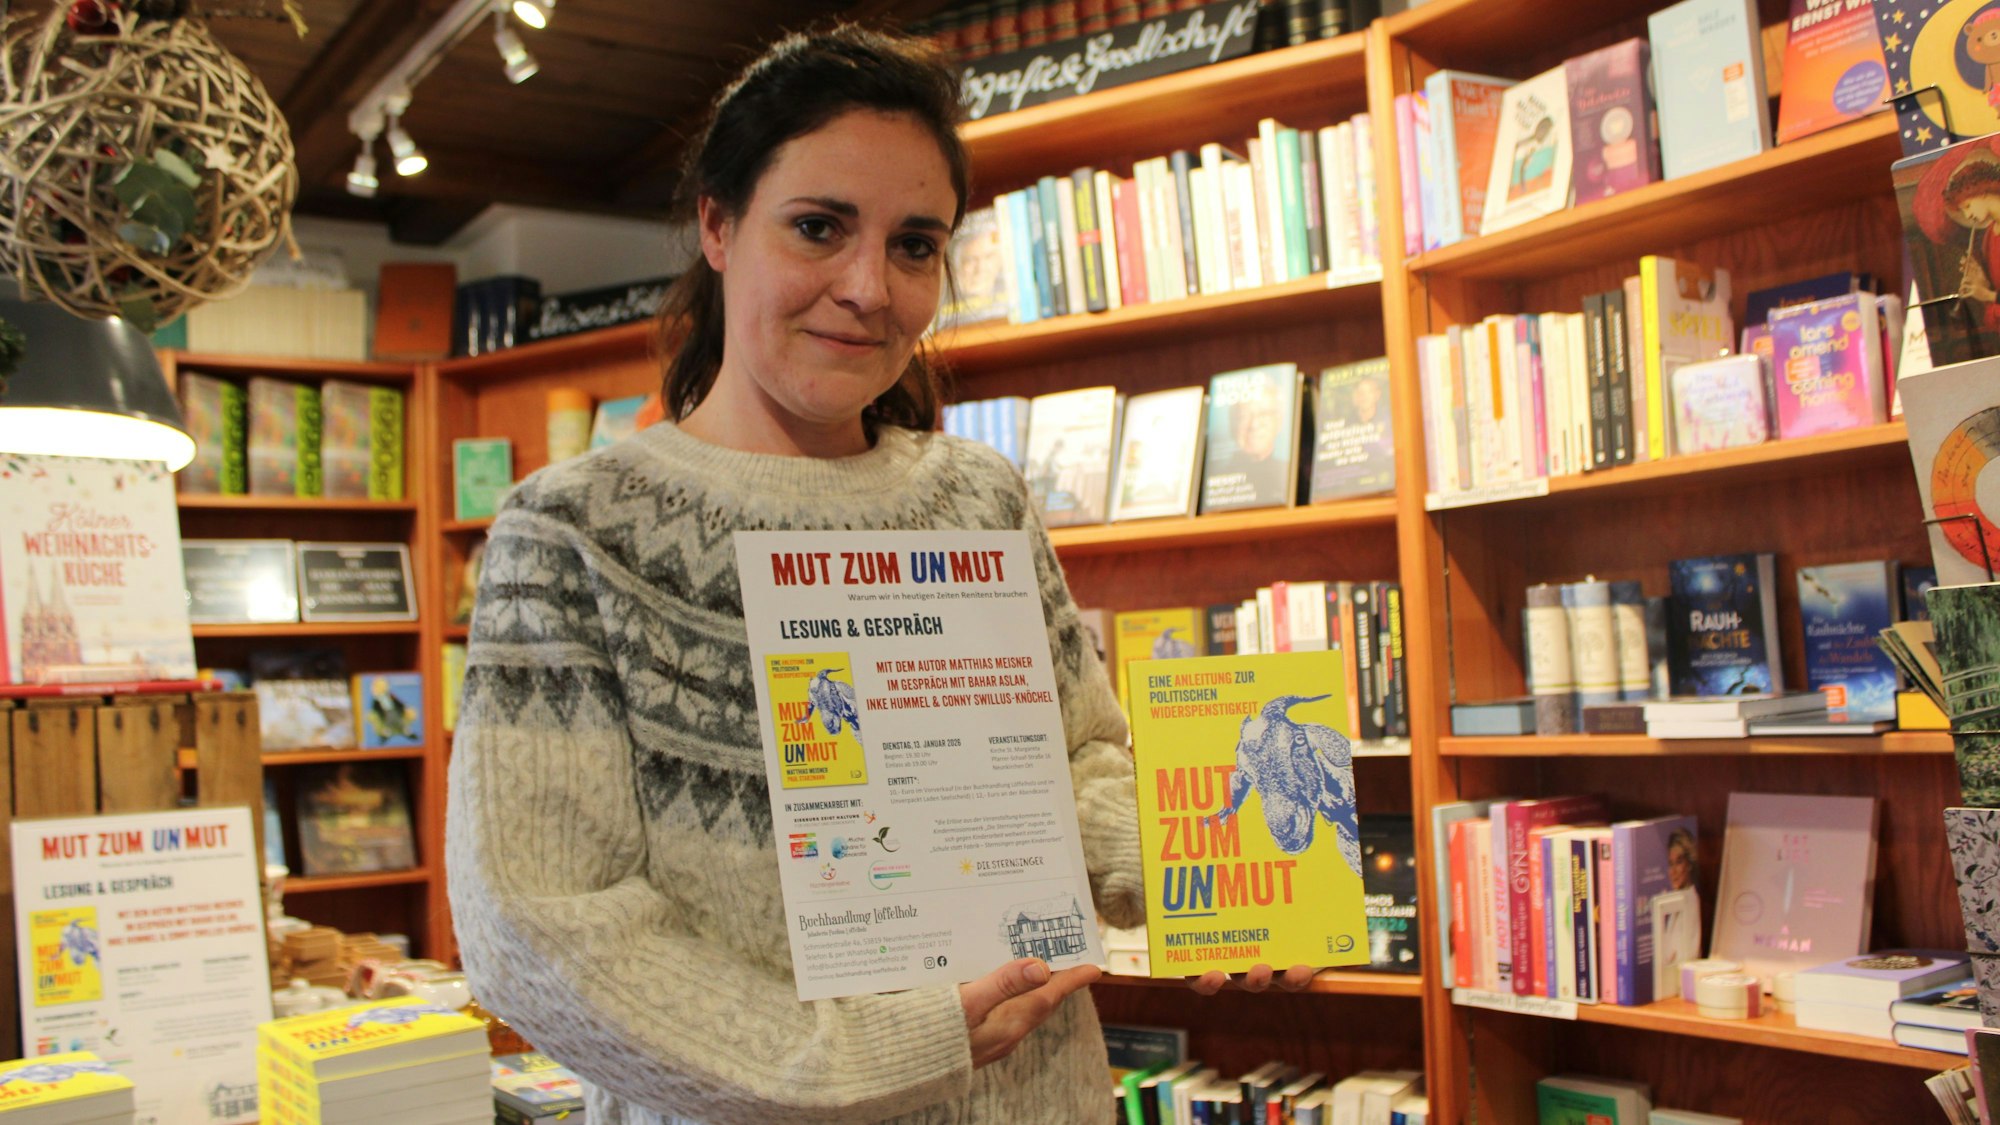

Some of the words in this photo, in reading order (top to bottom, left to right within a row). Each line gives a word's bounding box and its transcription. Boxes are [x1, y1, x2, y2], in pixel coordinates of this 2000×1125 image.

[1792, 1, 1842, 32] ERNST
[1801, 324, 1835, 343] lars
[1790, 333, 1849, 360] amend
[1792, 371, 1856, 396] coming
[771, 553, 831, 586] MUT
[840, 552, 901, 585] ZUM
[910, 551, 1004, 583] UNMUT
[848, 593, 877, 602] Warum
[878, 592, 891, 601] wir
[893, 592, 900, 600] in
[901, 592, 935, 602] heutigen
[937, 591, 959, 600] Zeiten
[962, 591, 993, 599] Renitenz
[994, 590, 1028, 598] brauchen
[780, 619, 842, 640] LESUNG
[847, 618, 860, 637] &
[864, 613, 943, 636] GESPRÄCH
[876, 661, 892, 673] MIT
[895, 660, 916, 672] DEM
[918, 659, 947, 672] AUTOR
[949, 658, 993, 671] MATTHIAS
[995, 656, 1033, 669] MEISNER
[887, 680, 898, 691] IM
[901, 676, 948, 691] GESPRÄCH
[950, 677, 965, 689] MIT
[968, 675, 996, 688] BAHAR
[999, 674, 1029, 687] ASLAN,
[1148, 675, 1172, 688] EINE
[1174, 672, 1232, 686] ANLEITUNG
[1234, 671, 1255, 684] ZUR
[866, 698, 888, 710] INKE
[890, 697, 930, 710] HUMMEL
[933, 696, 941, 708] &
[942, 694, 971, 707] CONNY
[974, 690, 1053, 706] SWILLUS-KNÖCHEL
[1149, 688, 1218, 704] POLITISCHEN
[778, 701, 810, 721] MUT
[1150, 701, 1258, 719] WIDERSPENSTIGKEIT
[781, 722, 815, 742] ZUM
[785, 742, 838, 763] UNMUT
[882, 742, 913, 751] DIENSTAG,
[923, 740, 946, 748] JANUAR
[947, 738, 961, 747] 2026
[1156, 765, 1236, 813] MUT
[785, 803, 792, 812] IN
[793, 800, 849, 812] ZUSAMMENARBEIT
[42, 834, 91, 860] MUT
[98, 830, 144, 856] ZUM
[153, 824, 229, 851] UNMUT
[1159, 814, 1241, 861] ZUM
[977, 861, 990, 870] DIE
[992, 856, 1044, 869] STERNSINGER
[43, 880, 93, 899] LESUNG
[111, 874, 174, 894] GESPRÄCH
[1162, 860, 1297, 912] UNMUT
[799, 910, 871, 931] Buchhandlung
[1165, 930, 1219, 947] MATTHIAS
[1222, 928, 1270, 944] MEISNER
[1166, 949, 1192, 963] PAUL
[1196, 945, 1261, 961] STARZMANN
